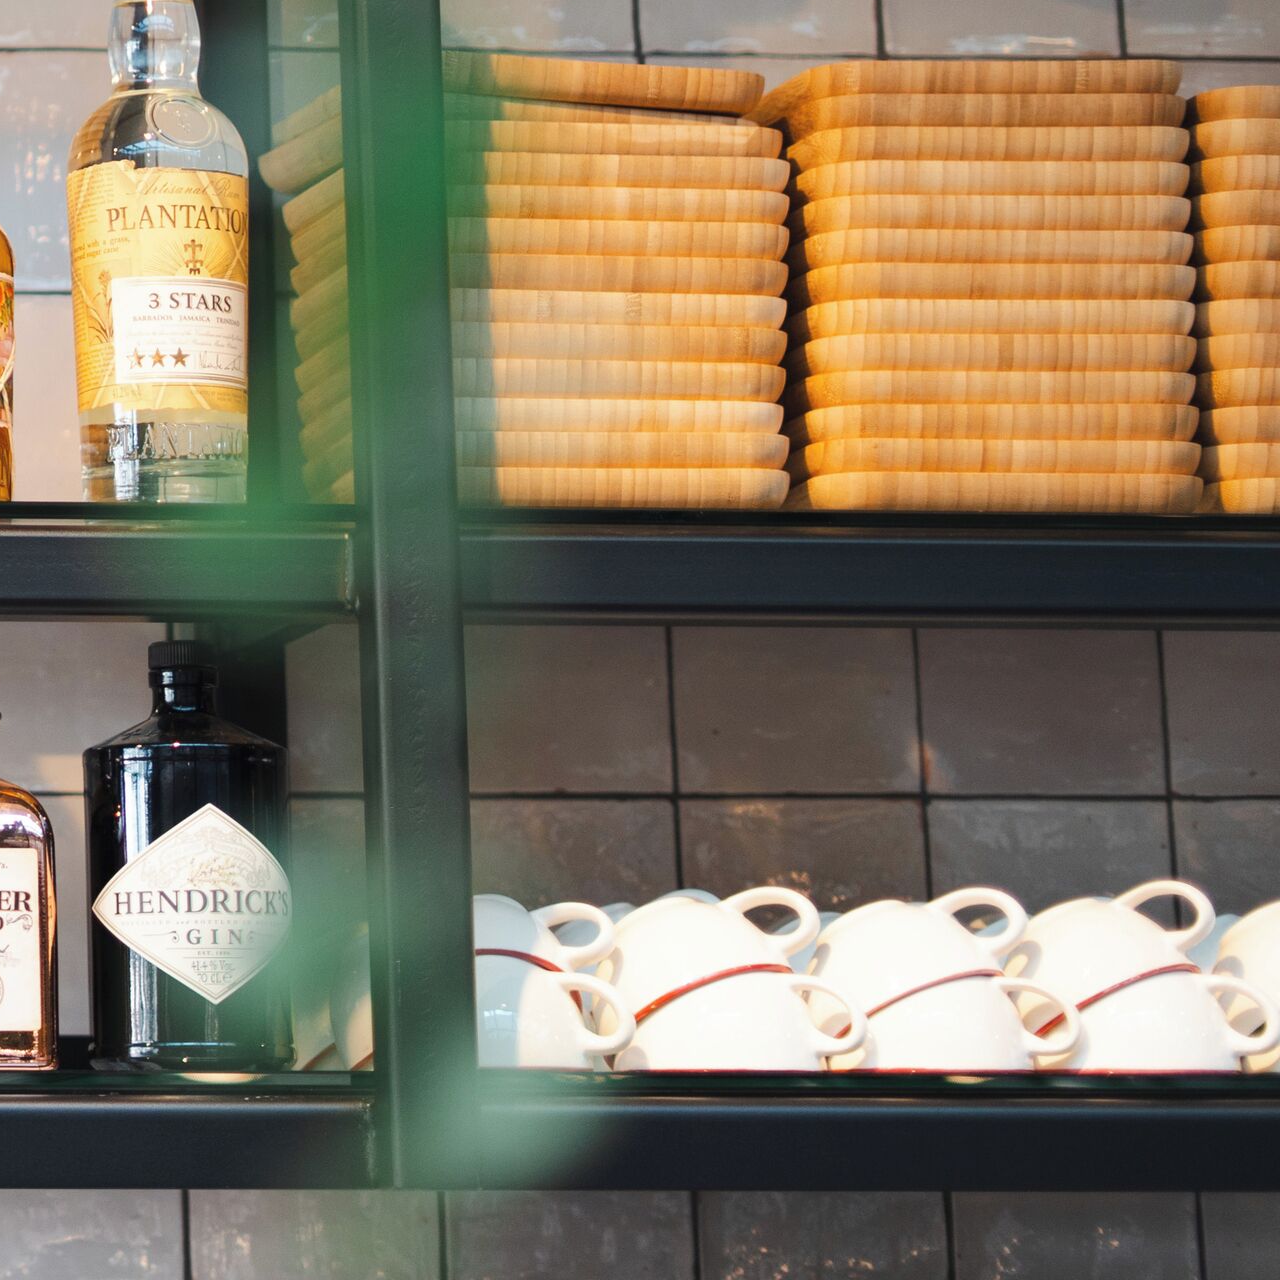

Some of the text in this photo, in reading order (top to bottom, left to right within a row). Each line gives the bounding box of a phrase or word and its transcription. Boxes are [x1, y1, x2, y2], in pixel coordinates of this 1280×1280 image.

[148, 291, 232, 313] 3 STARS
[179, 314, 211, 323] JAMAICA
[113, 888, 289, 917] HENDRICK'S
[186, 928, 244, 945] GIN
